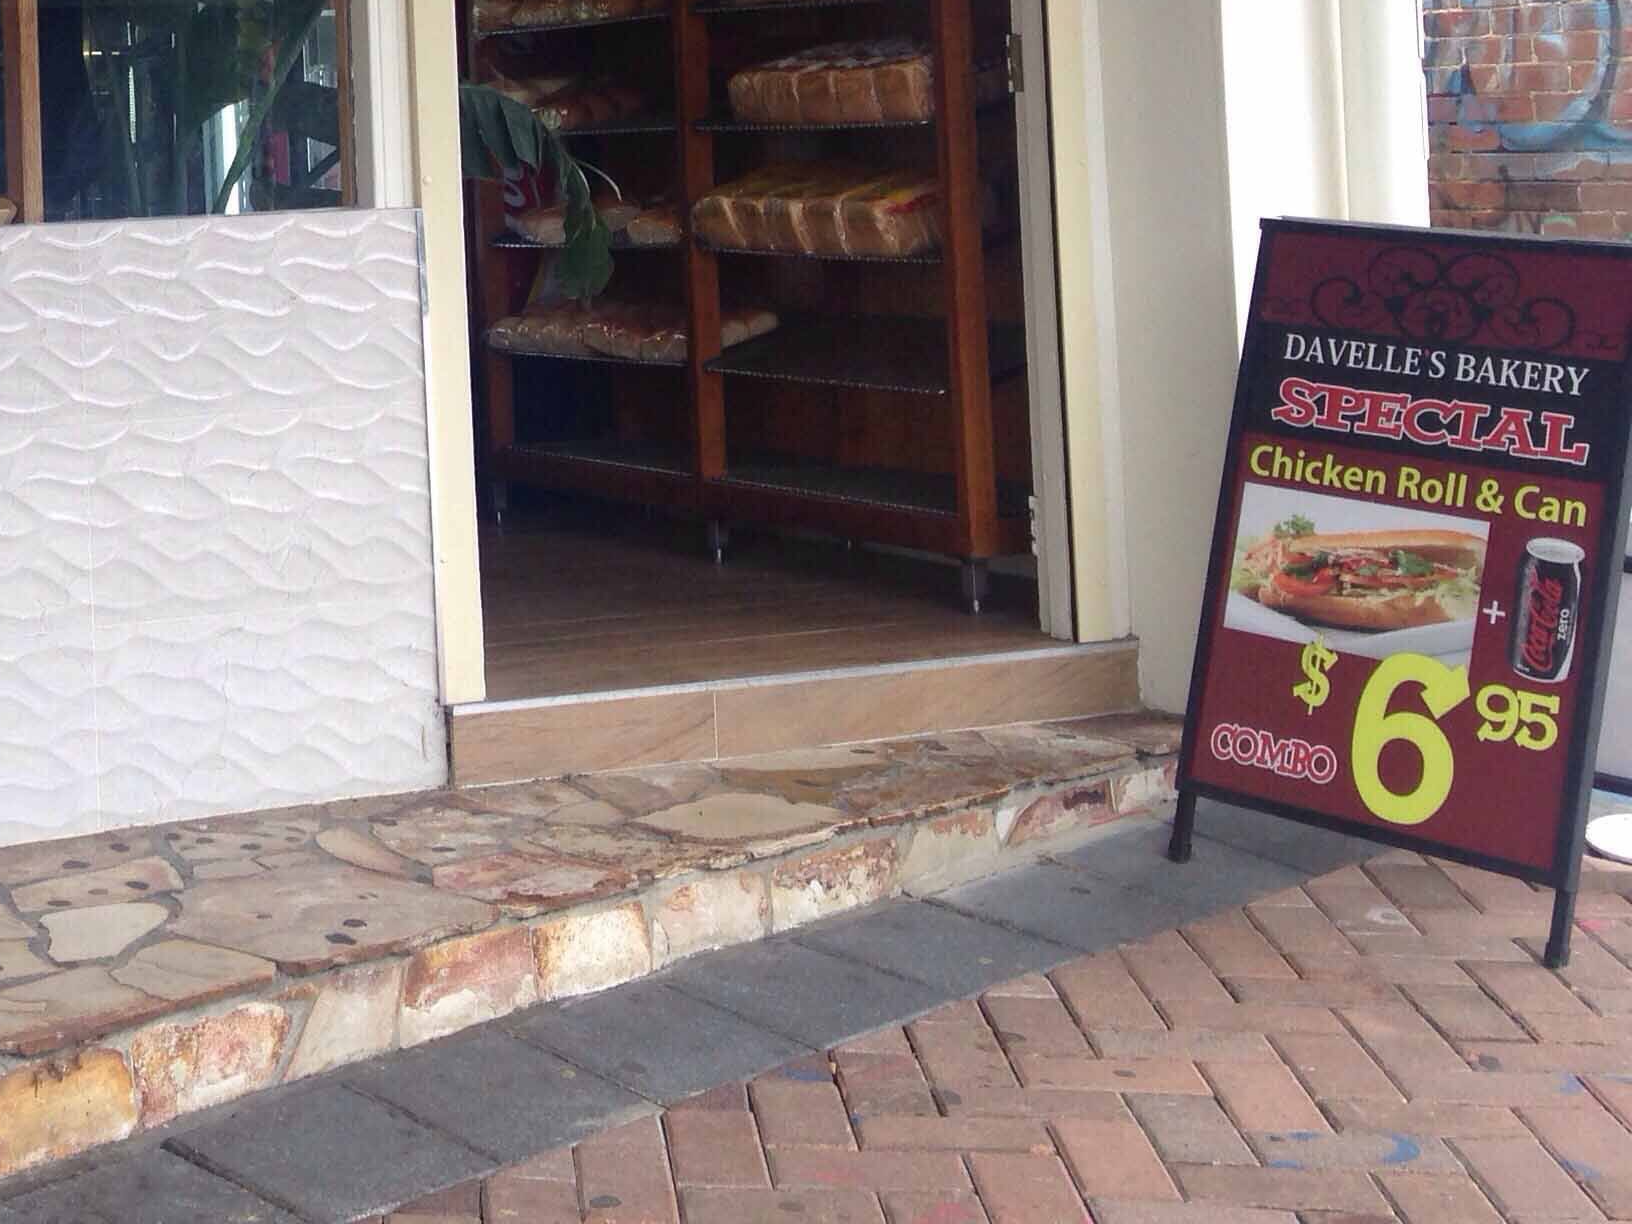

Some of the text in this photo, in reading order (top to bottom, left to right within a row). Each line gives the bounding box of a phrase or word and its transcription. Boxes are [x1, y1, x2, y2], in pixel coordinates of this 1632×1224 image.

[1284, 334, 1590, 396] DAVELLE'S BAKERY
[1272, 377, 1590, 465] SPECIAL
[1250, 445, 1587, 527] Chicken Roll & Can
[1557, 608, 1570, 641] zero
[1210, 723, 1337, 784] COMBO
[1352, 652, 1470, 825] 6
[1475, 685, 1560, 751] 95
